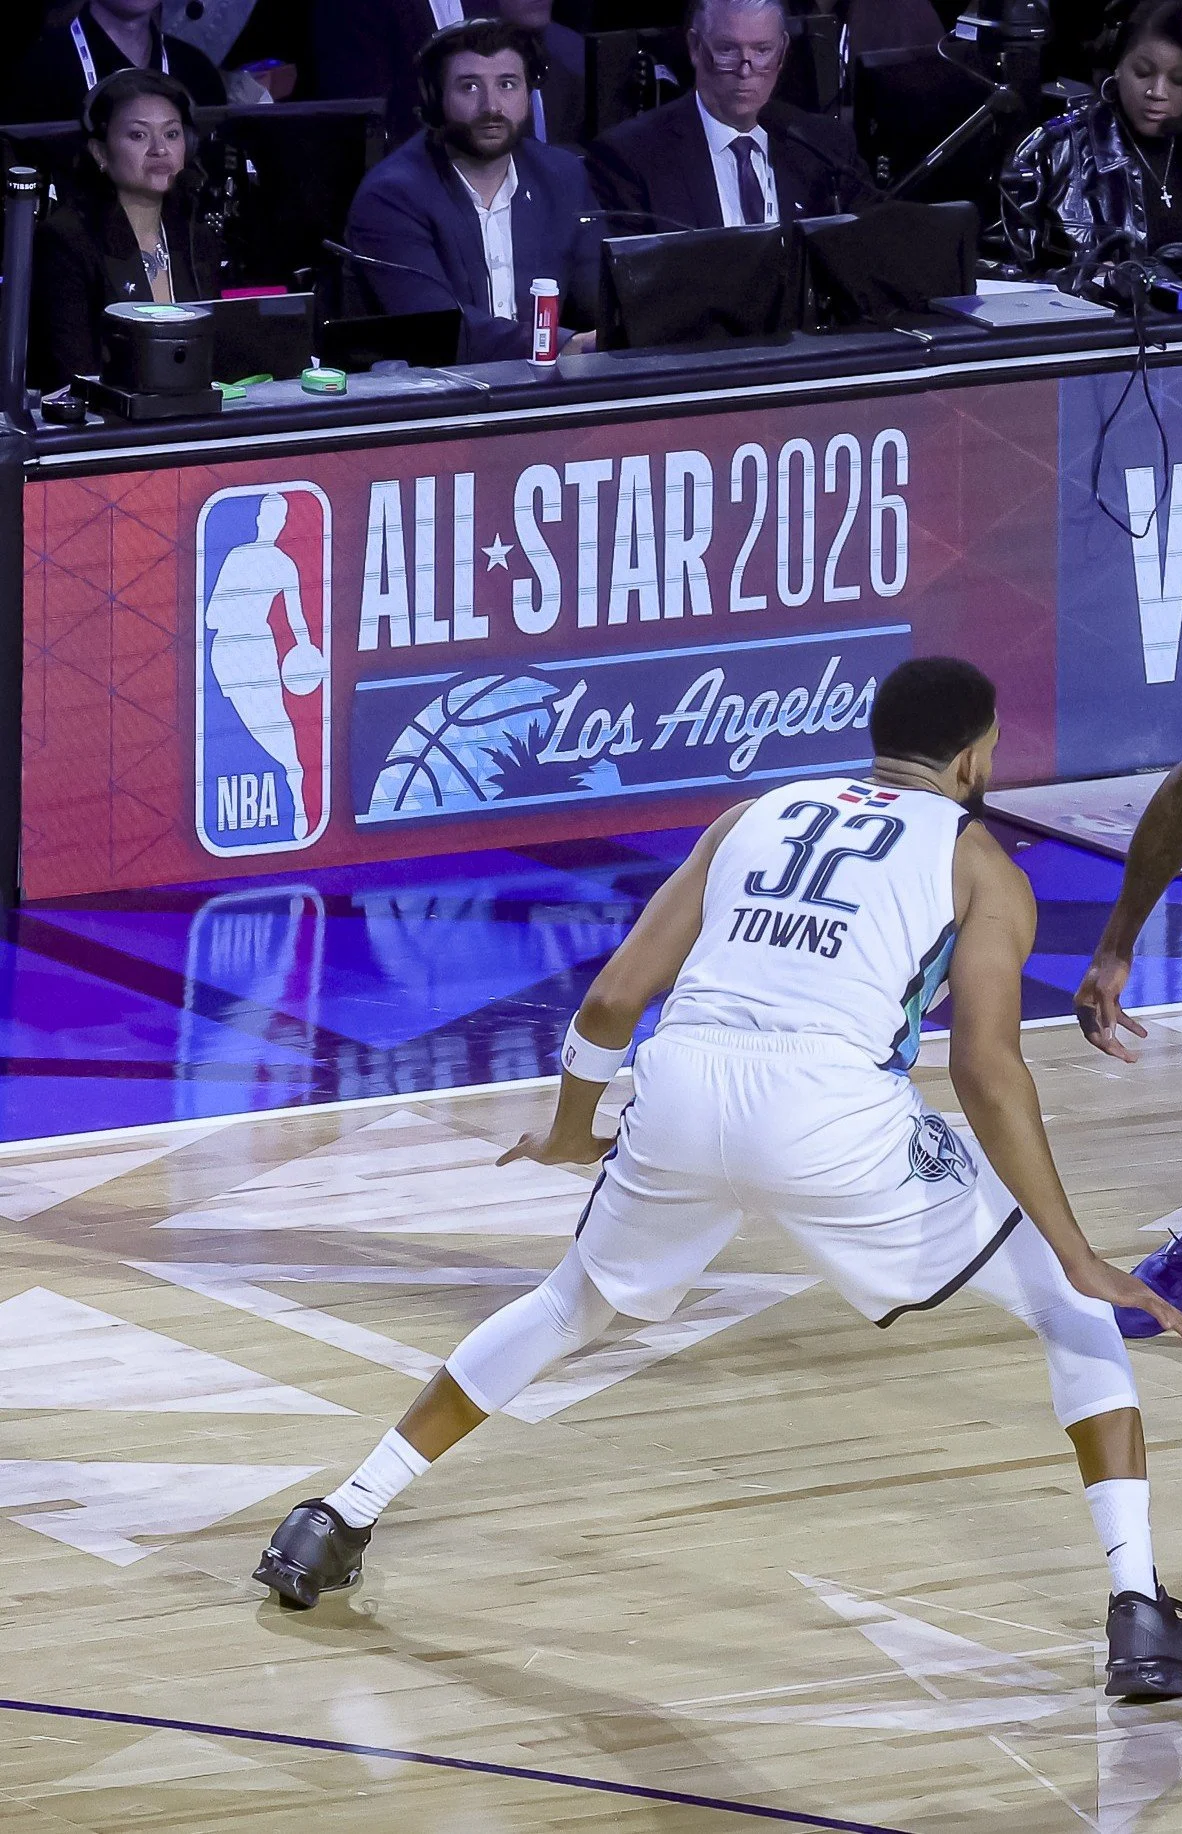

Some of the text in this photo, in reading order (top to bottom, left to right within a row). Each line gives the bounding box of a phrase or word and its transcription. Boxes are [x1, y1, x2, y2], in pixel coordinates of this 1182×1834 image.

[357, 428, 909, 652] ALL STAR 2026
[537, 656, 877, 772] Los Angeles
[217, 771, 279, 832] NBA
[743, 800, 906, 915] 32
[728, 908, 848, 959] TOWNS
